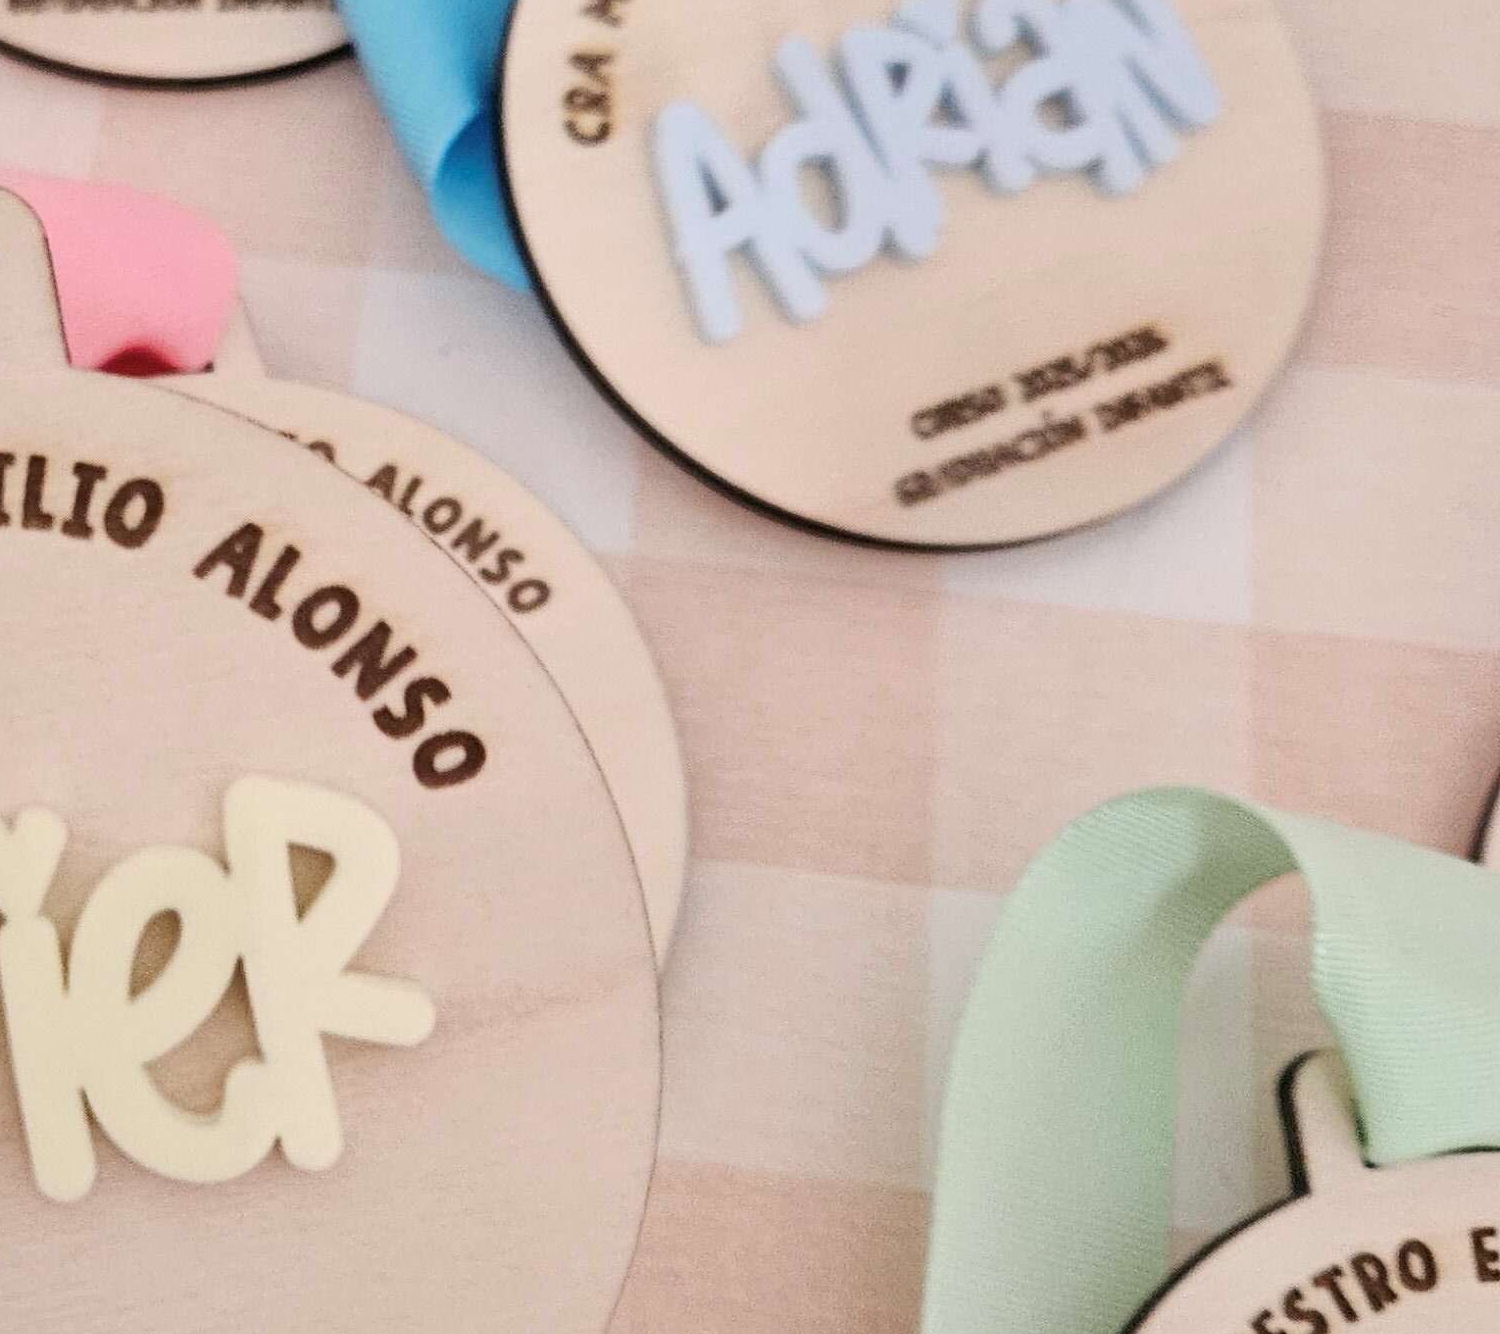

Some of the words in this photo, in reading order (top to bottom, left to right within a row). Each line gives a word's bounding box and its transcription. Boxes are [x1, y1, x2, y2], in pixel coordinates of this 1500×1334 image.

[561, 46, 613, 147] CRA
[362, 461, 551, 614] ALONSO
[191, 520, 488, 791] ALONSO
